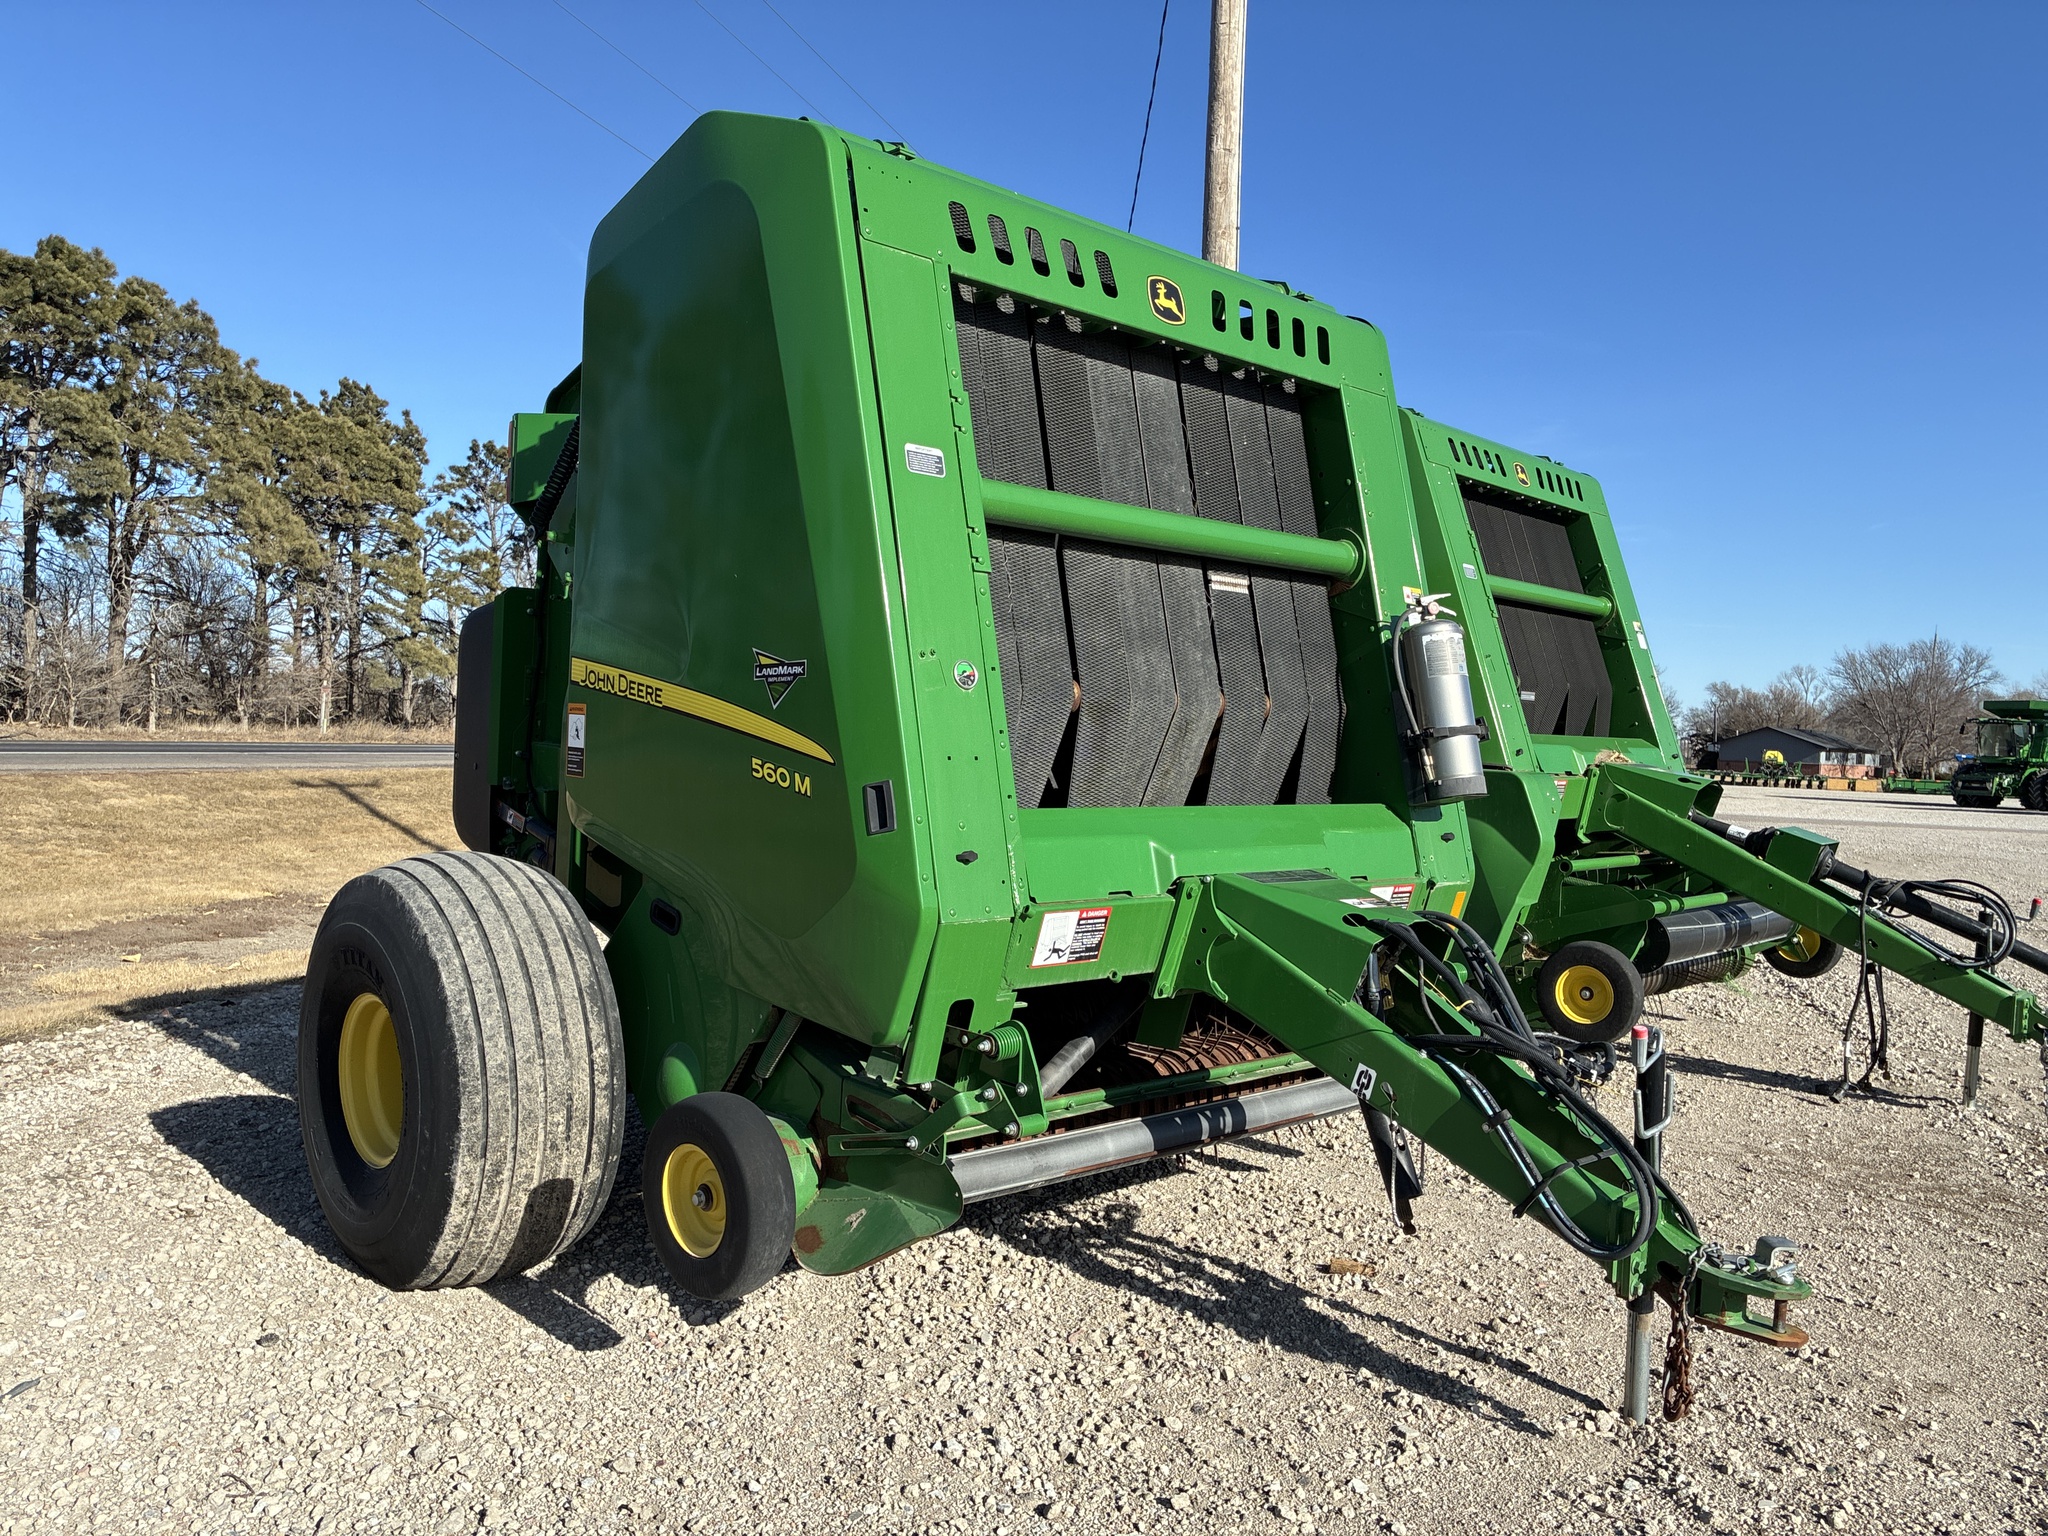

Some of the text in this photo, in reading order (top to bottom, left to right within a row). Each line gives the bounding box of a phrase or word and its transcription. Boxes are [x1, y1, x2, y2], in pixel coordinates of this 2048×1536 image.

[580, 665, 663, 705] JOHN DEERE
[751, 756, 811, 797] 560 M
[1087, 909, 1108, 918] DANGER
